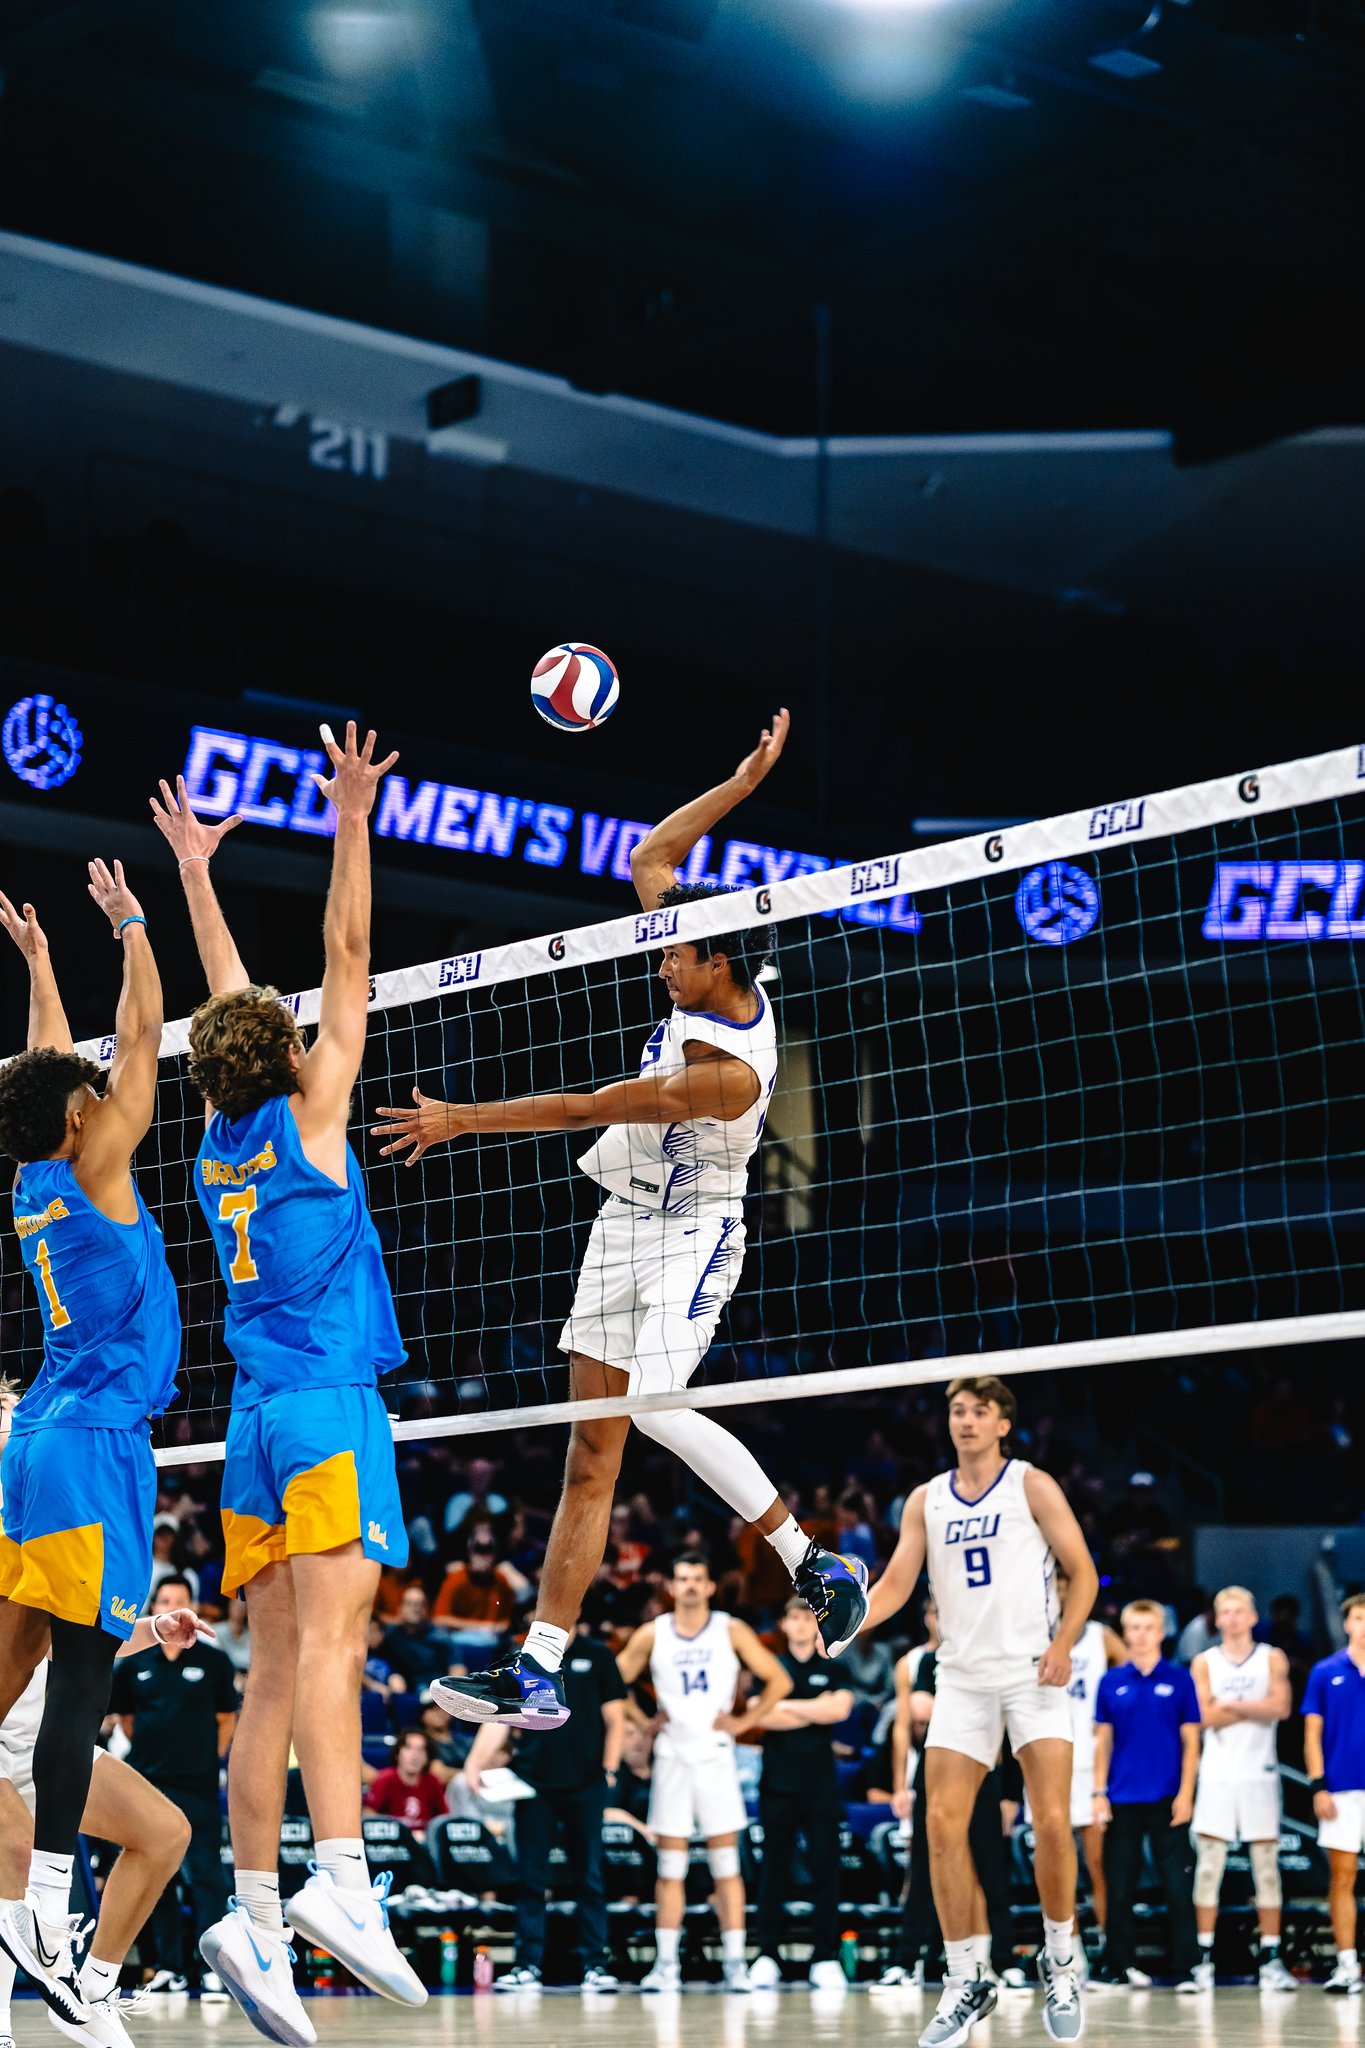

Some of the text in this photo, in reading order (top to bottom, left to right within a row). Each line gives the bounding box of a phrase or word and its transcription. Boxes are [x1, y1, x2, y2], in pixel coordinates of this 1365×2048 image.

[1238, 774, 1260, 803] G
[374, 774, 574, 867] MEN'S
[1089, 799, 1146, 840] GCU
[984, 835, 1004, 862] G
[850, 857, 901, 895] GCU
[755, 888, 772, 915] G
[635, 908, 680, 943] GCU
[548, 935, 566, 962] G
[439, 953, 483, 988] GCU
[218, 1184, 260, 1285] 7
[34, 1238, 72, 1331] 1
[944, 1513, 1002, 1545] GCU
[964, 1546, 992, 1589] 9
[680, 1669, 709, 1697] 14
